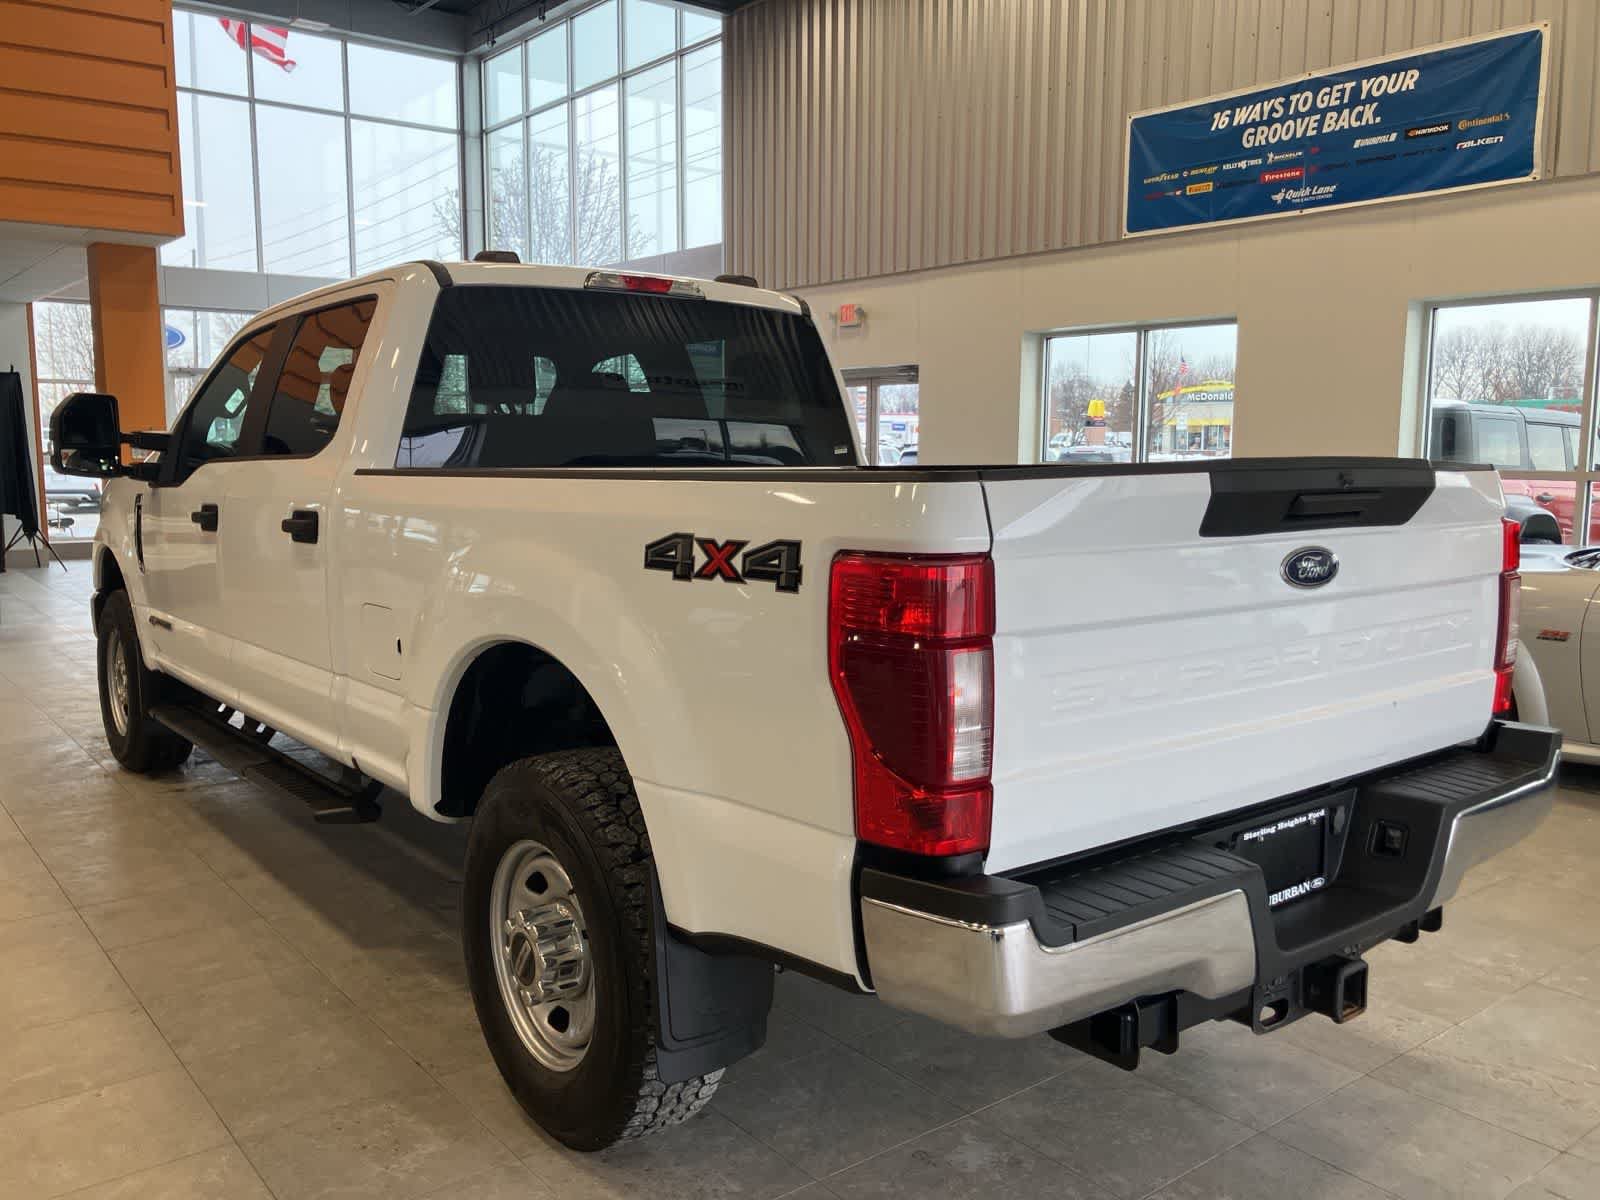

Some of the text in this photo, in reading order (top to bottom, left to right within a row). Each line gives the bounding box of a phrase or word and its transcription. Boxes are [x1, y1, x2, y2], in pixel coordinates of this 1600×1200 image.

[1210, 69, 1420, 131] 16 WAYS TO GET YOUR
[1242, 102, 1382, 149] GROOVE BACK.
[1457, 113, 1504, 131] Continental
[1264, 171, 1300, 181] Firestone
[1285, 184, 1337, 200] Quick Lane
[1187, 392, 1233, 401] McDonald
[1297, 555, 1330, 578] Ford
[1243, 809, 1325, 840] Sterling Heights Ford
